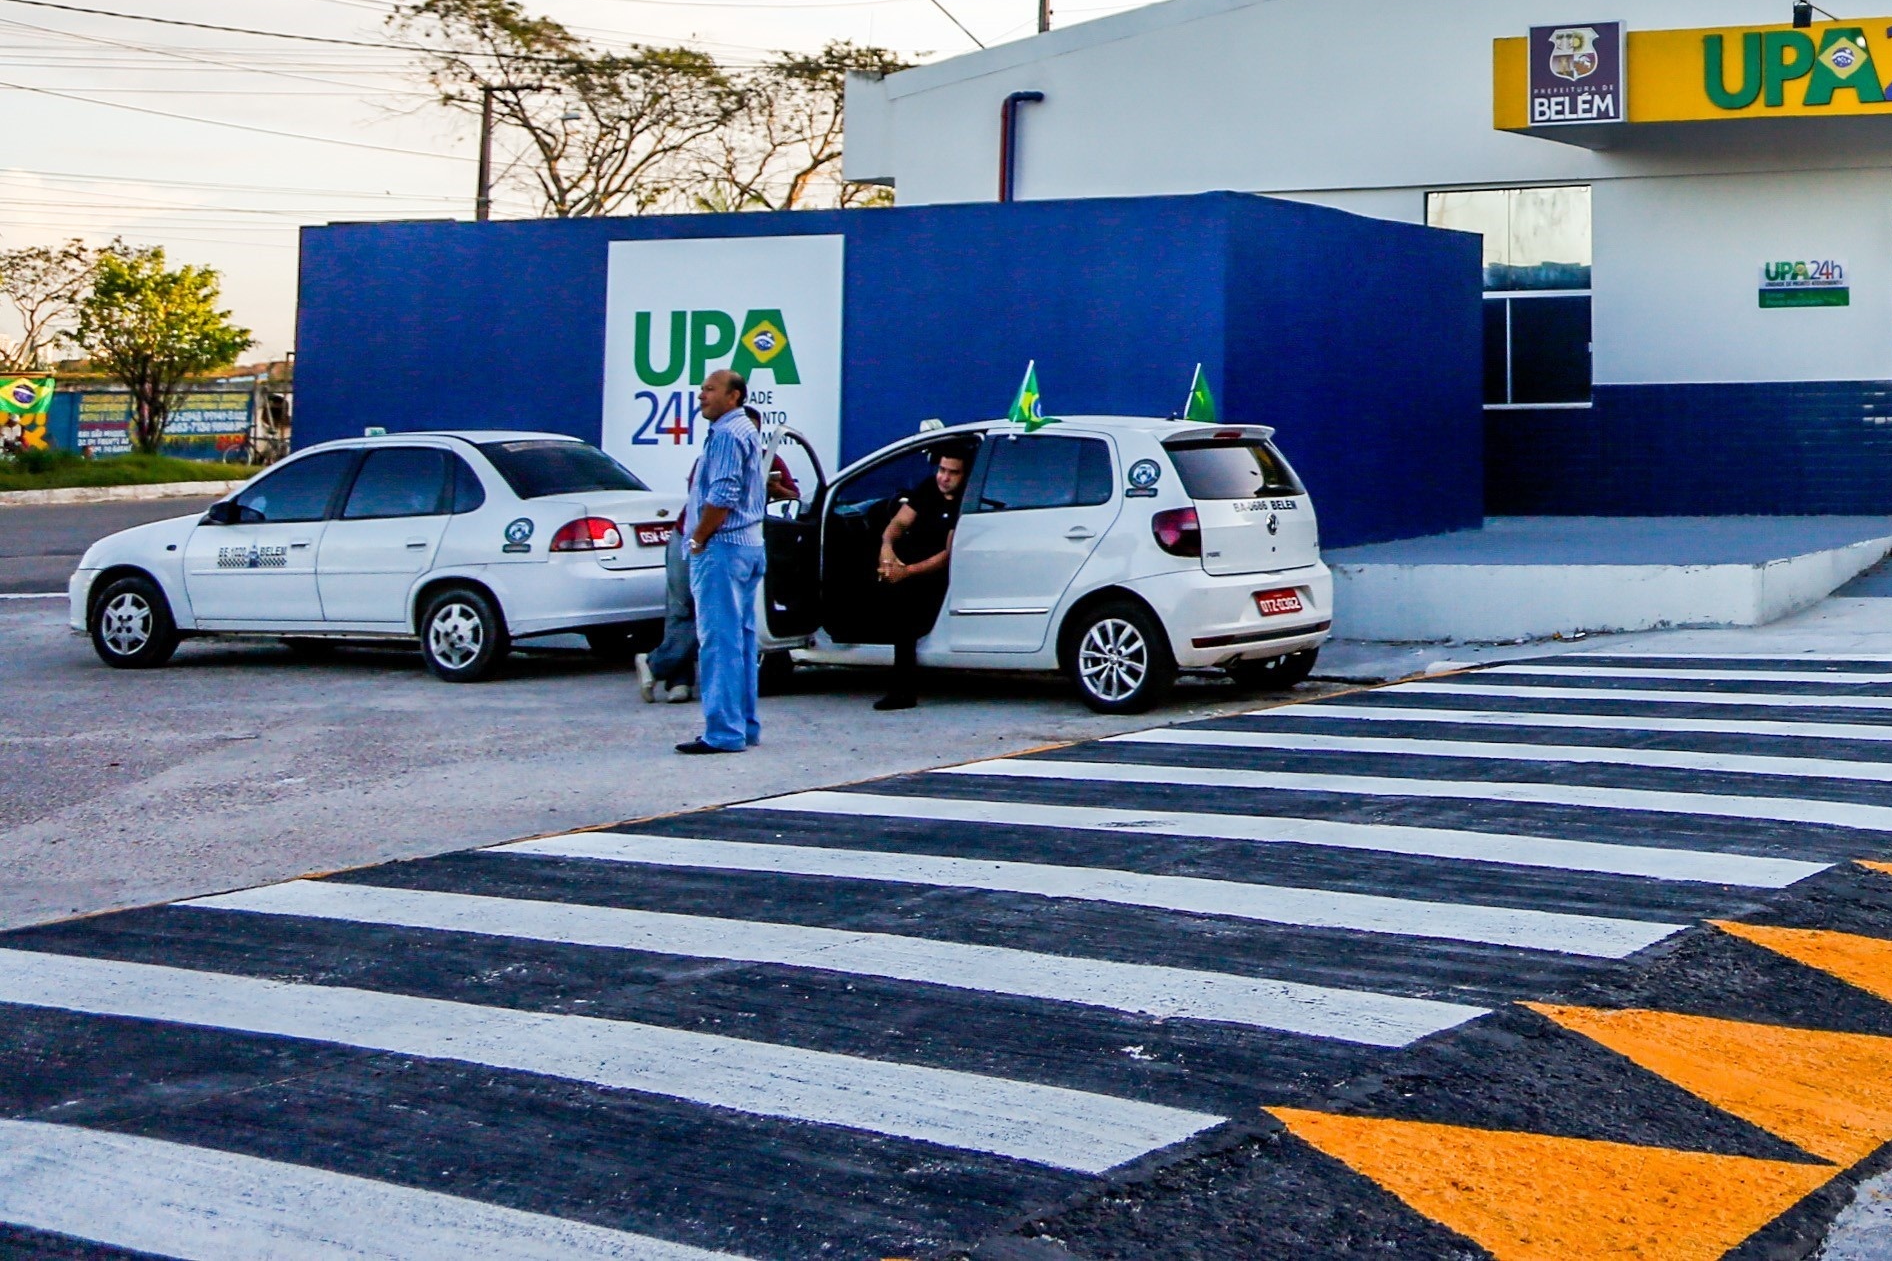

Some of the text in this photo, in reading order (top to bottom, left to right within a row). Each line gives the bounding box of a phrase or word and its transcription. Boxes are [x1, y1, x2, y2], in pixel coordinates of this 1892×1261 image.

[1703, 27, 1887, 110] UPA
[1534, 85, 1597, 94] PREFEITURA
[1533, 92, 1615, 121] BELÉM
[1765, 260, 1843, 281] UPA 24h
[634, 308, 801, 387] UPA
